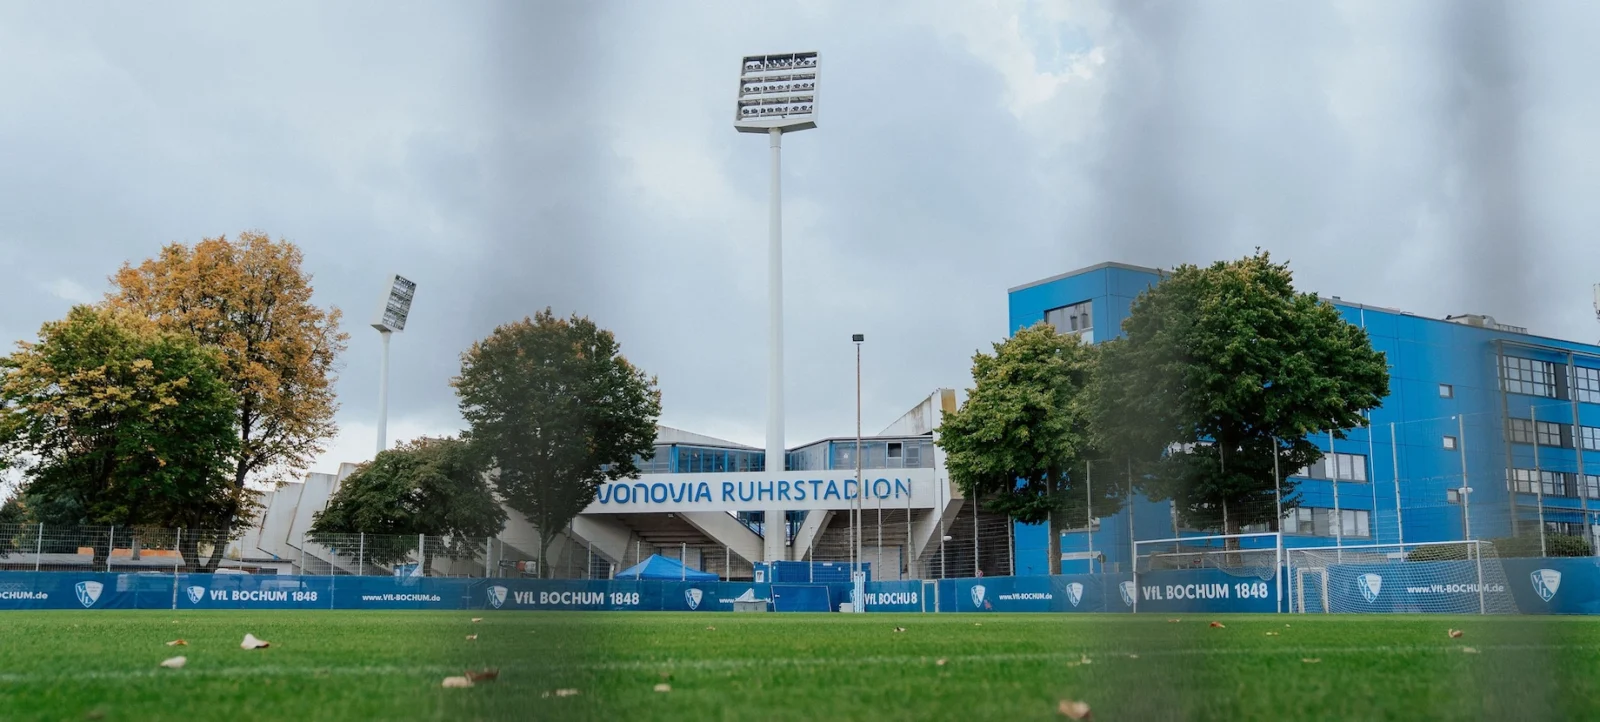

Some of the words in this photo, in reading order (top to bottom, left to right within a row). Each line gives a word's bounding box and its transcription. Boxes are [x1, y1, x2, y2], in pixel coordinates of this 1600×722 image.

[597, 482, 712, 504] VONOVIA
[722, 478, 911, 502] RUHRSTADION
[1142, 586, 1163, 600] VfL
[1166, 584, 1229, 600] BOCHUM
[1234, 583, 1268, 598] 1848
[1406, 584, 1504, 593] www.VfL-BOCHUM.de
[0, 591, 48, 599] CHUM.de
[210, 590, 228, 601] VfL
[232, 590, 287, 601] BOCHUM
[292, 591, 318, 602] 1848
[362, 594, 440, 602] www.VfL-BOCHUM.de
[514, 592, 535, 604] VfL
[540, 592, 604, 605] BOCHUM
[610, 592, 640, 605] 1848
[865, 593, 877, 605] VfL
